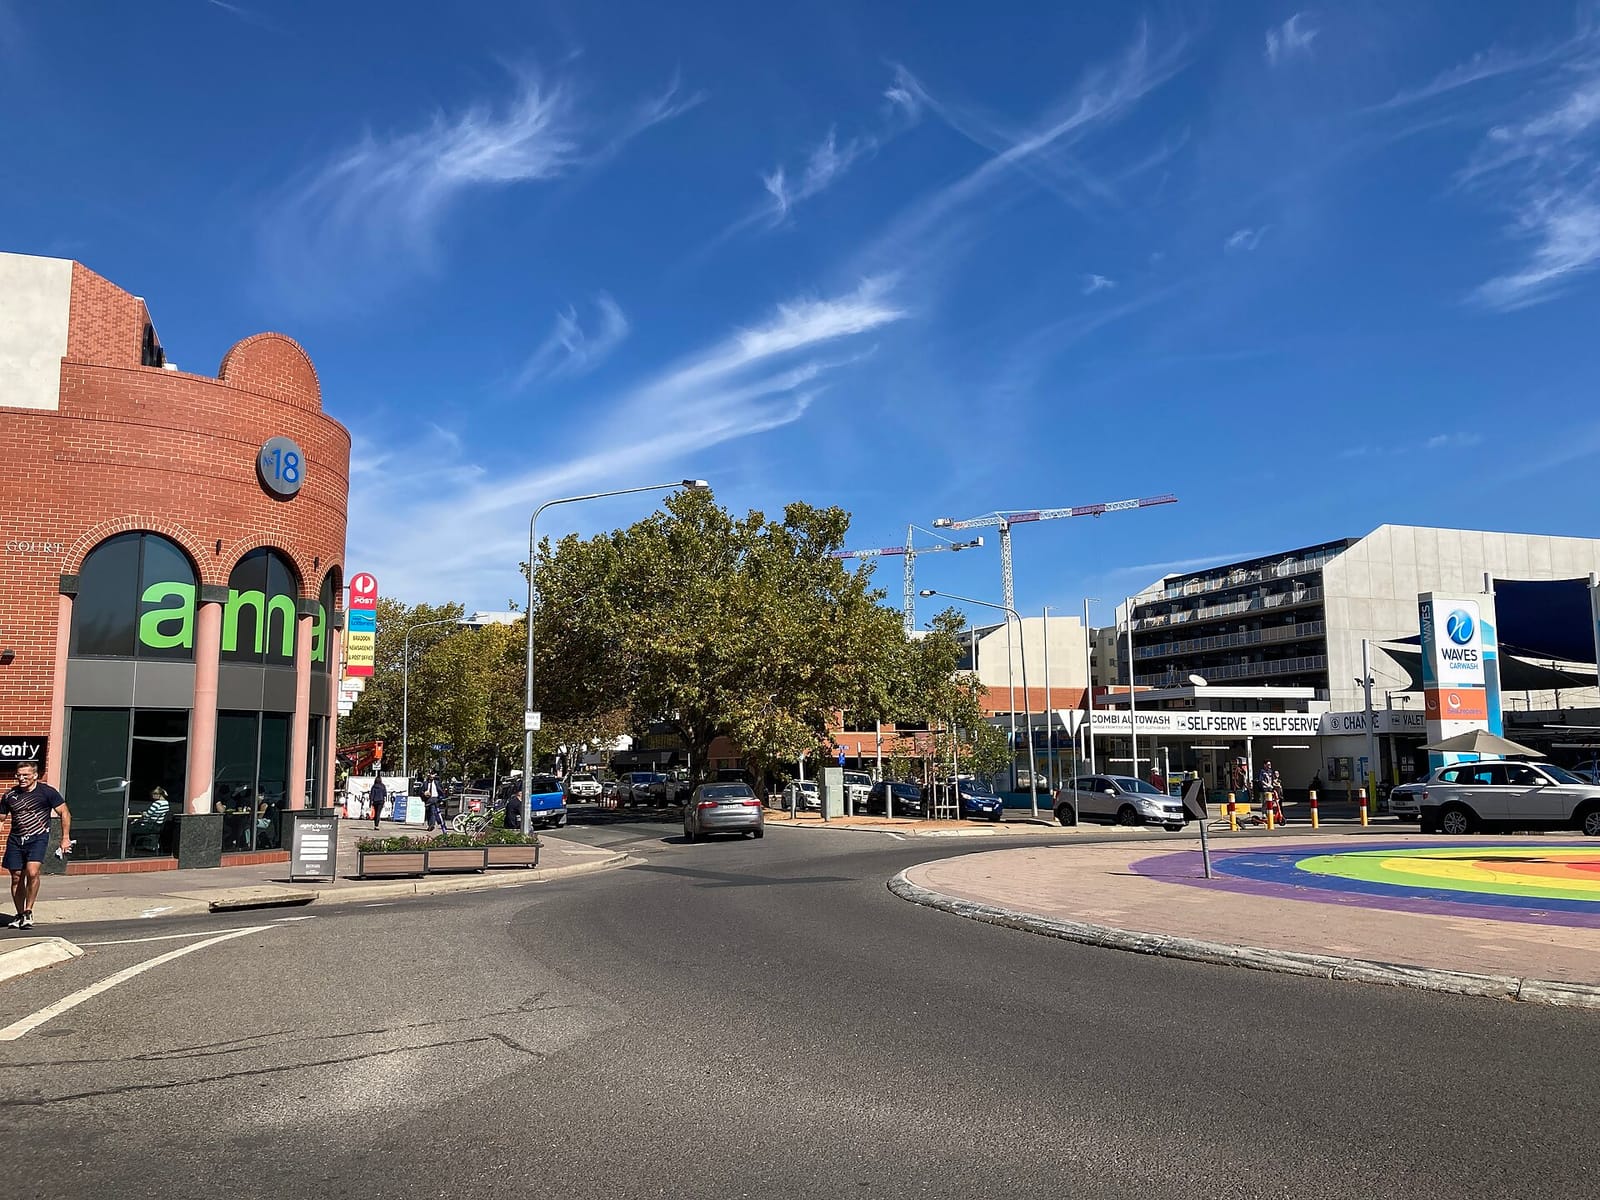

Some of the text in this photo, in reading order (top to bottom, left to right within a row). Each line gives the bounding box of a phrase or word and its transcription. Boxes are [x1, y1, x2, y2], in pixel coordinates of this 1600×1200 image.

[272, 448, 299, 483] 18
[7, 541, 64, 553] COURT
[1421, 604, 1432, 643] WAVES
[1441, 648, 1478, 661] WAVES
[1092, 714, 1170, 724] COMBI AUTOWASH
[1343, 714, 1380, 729] CHANE
[1403, 715, 1424, 725] VALET
